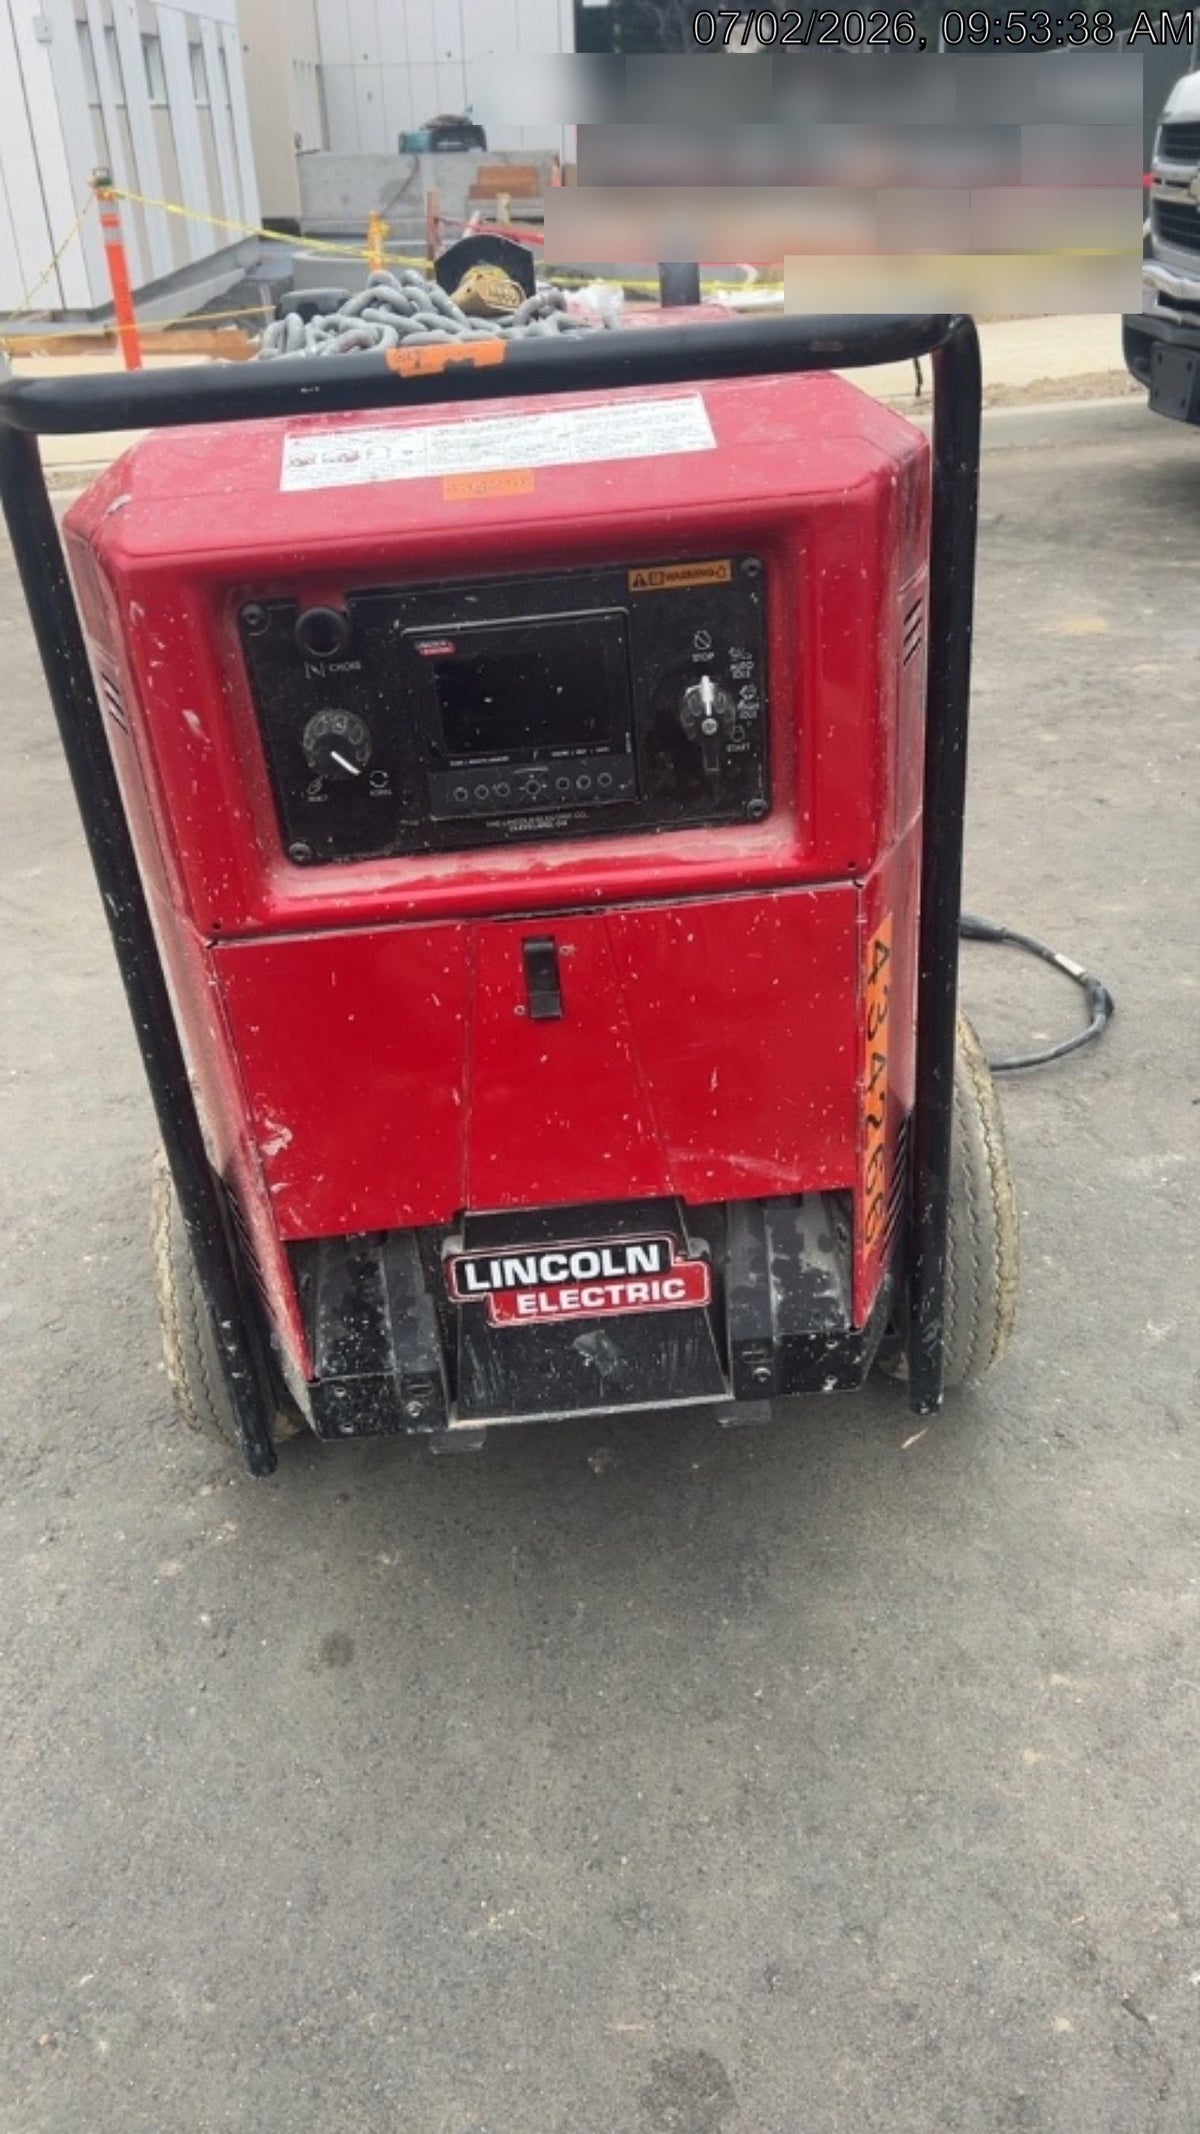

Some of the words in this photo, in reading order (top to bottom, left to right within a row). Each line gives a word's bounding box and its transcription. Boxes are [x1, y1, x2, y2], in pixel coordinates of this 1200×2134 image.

[665, 567, 714, 581] WARNING
[464, 1244, 661, 1291] LINCOLN
[515, 1277, 686, 1316] ELECTRIC
